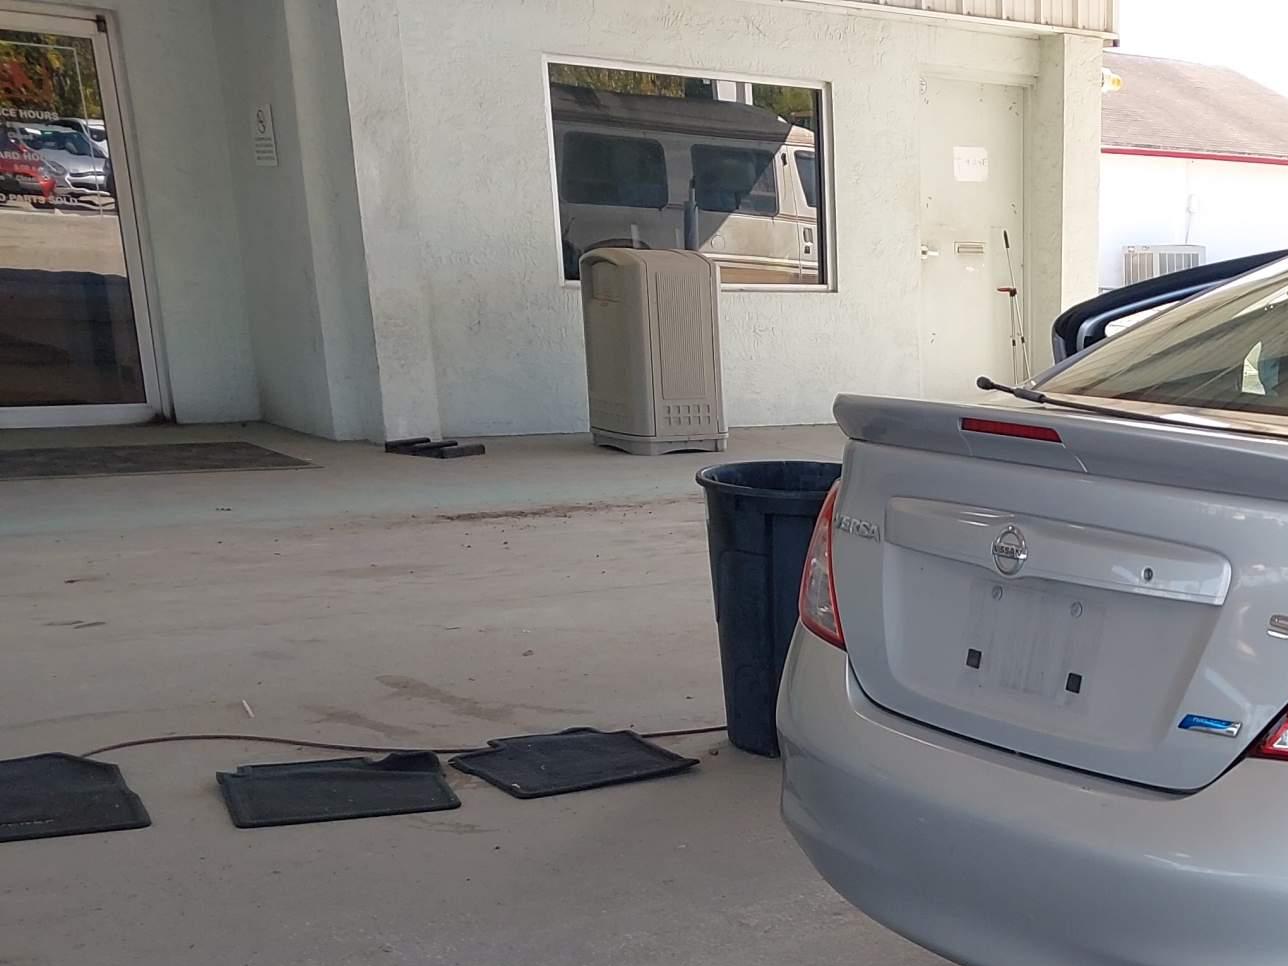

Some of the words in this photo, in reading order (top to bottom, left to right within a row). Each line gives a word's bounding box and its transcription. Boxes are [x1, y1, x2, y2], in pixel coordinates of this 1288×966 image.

[0, 108, 17, 118] CE
[19, 109, 59, 121] HOURS
[9, 193, 46, 204] PARTS
[48, 195, 78, 204] SOLD
